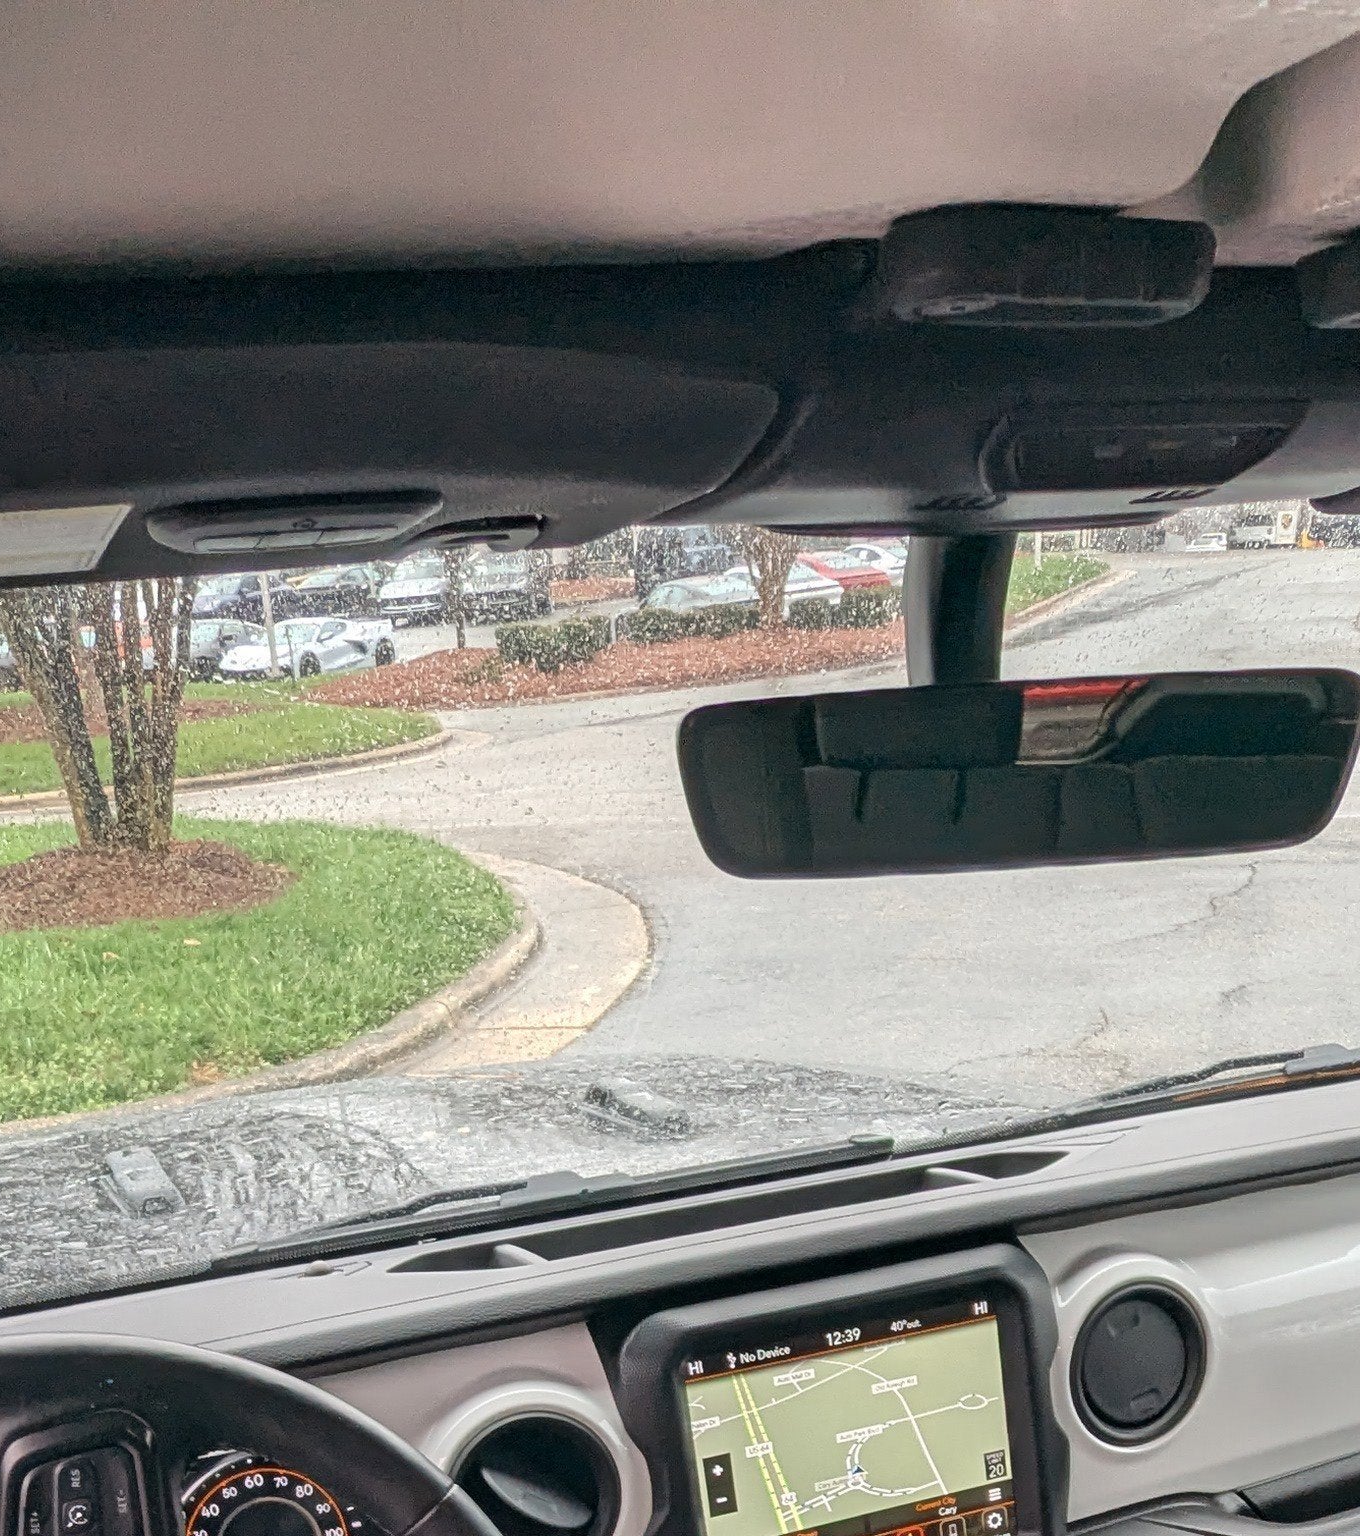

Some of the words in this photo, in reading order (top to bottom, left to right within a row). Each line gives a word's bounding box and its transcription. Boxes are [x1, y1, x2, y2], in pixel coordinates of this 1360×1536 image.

[974, 1301, 988, 1315] HI
[826, 1328, 861, 1346] 12:39
[740, 1352, 756, 1364] No
[757, 1346, 791, 1361] Device
[688, 1360, 704, 1375] HI
[71, 1469, 81, 1488] RES
[988, 1464, 1004, 1478] 20
[244, 1473, 264, 1489] 60
[273, 1476, 288, 1488] 70
[222, 1486, 238, 1499] 50
[295, 1483, 313, 1498] 80
[201, 1503, 220, 1518] 40
[316, 1502, 331, 1515] 90
[938, 1506, 958, 1517] Cary
